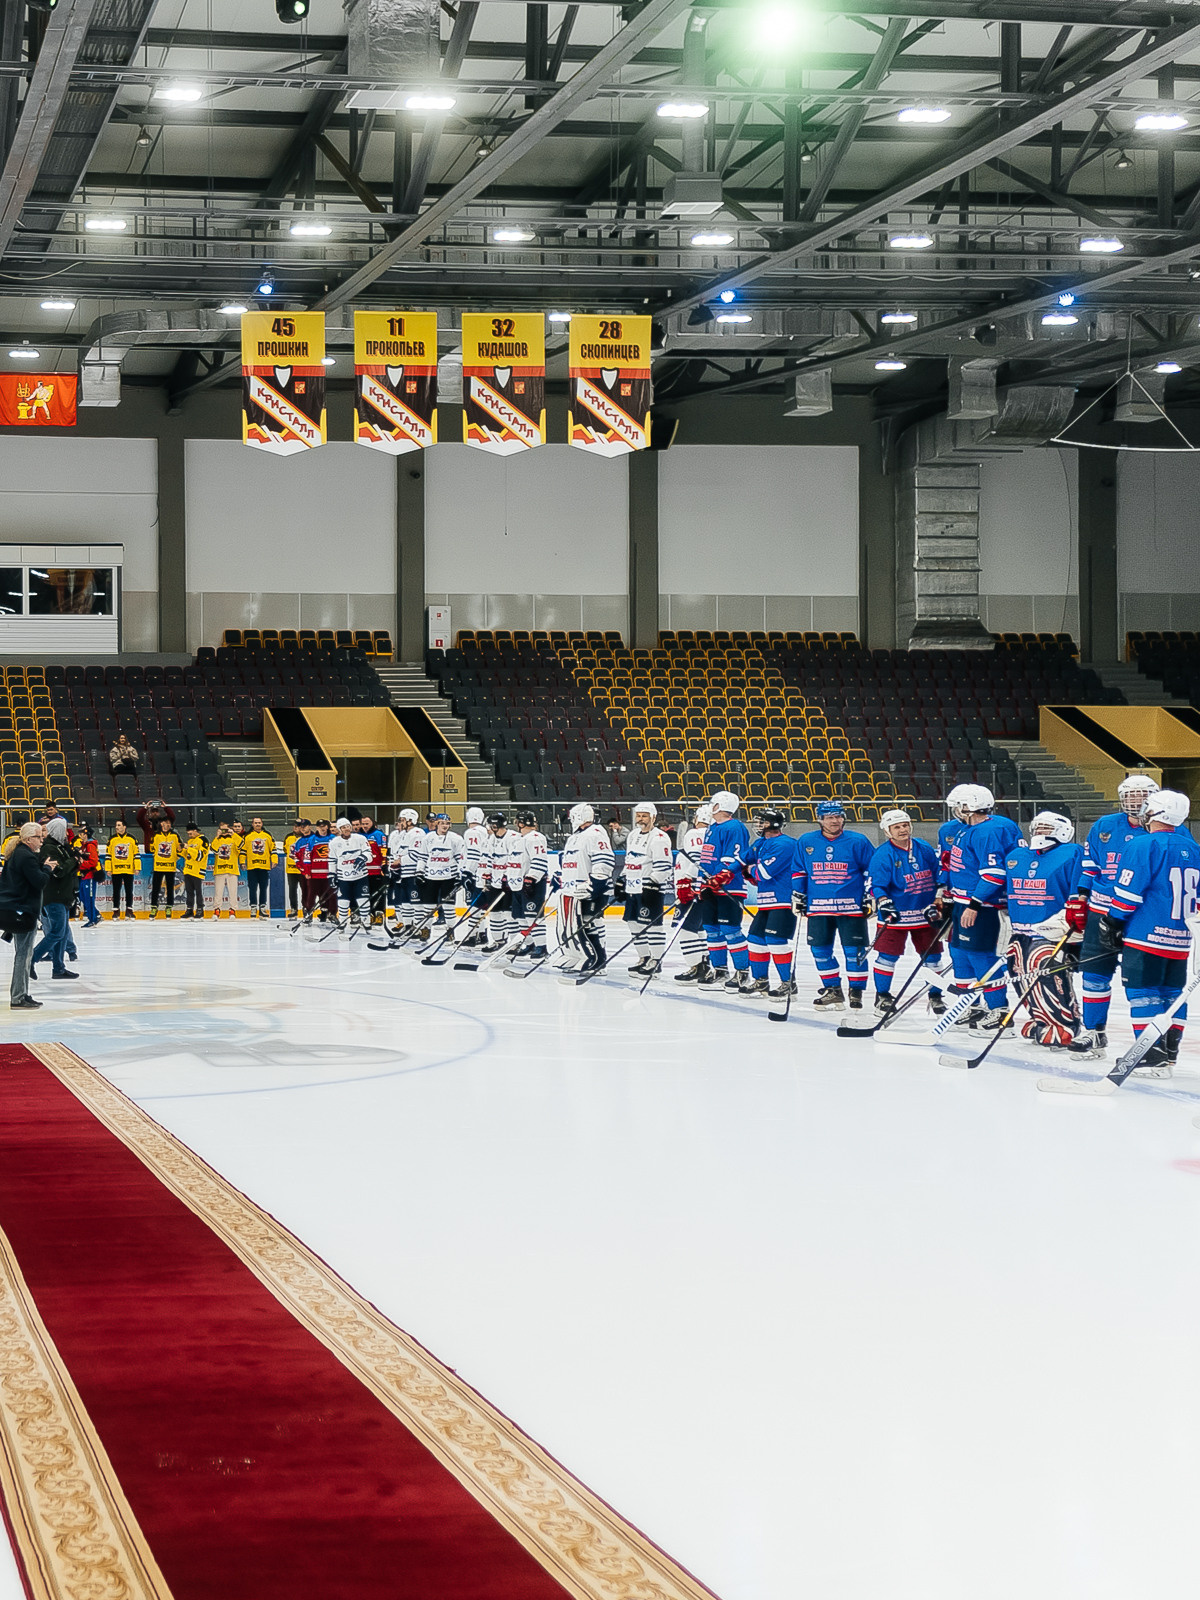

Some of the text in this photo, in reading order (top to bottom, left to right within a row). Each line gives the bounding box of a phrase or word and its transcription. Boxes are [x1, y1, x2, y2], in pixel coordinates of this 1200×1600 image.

[271, 317, 296, 337] 45
[386, 317, 405, 336] 11
[491, 318, 515, 338] 32
[598, 320, 623, 340] 28
[257, 341, 309, 358] ПРОШКИН
[365, 340, 426, 357] ПРОКОПЬЕВ
[477, 342, 529, 360] КУДАШОВ
[580, 342, 641, 362] СКОПИНЦЕВ
[257, 387, 315, 438] КРИСТАЛЛ
[368, 386, 425, 438] КРИСТАЛЛ
[477, 387, 534, 439] КРИСТАЛЛ
[583, 388, 640, 441] КРИСТАЛЛ
[988, 853, 997, 866] 5
[1023, 878, 1047, 889] НАШИ
[1119, 868, 1134, 887] 18
[1169, 867, 1199, 921] 18
